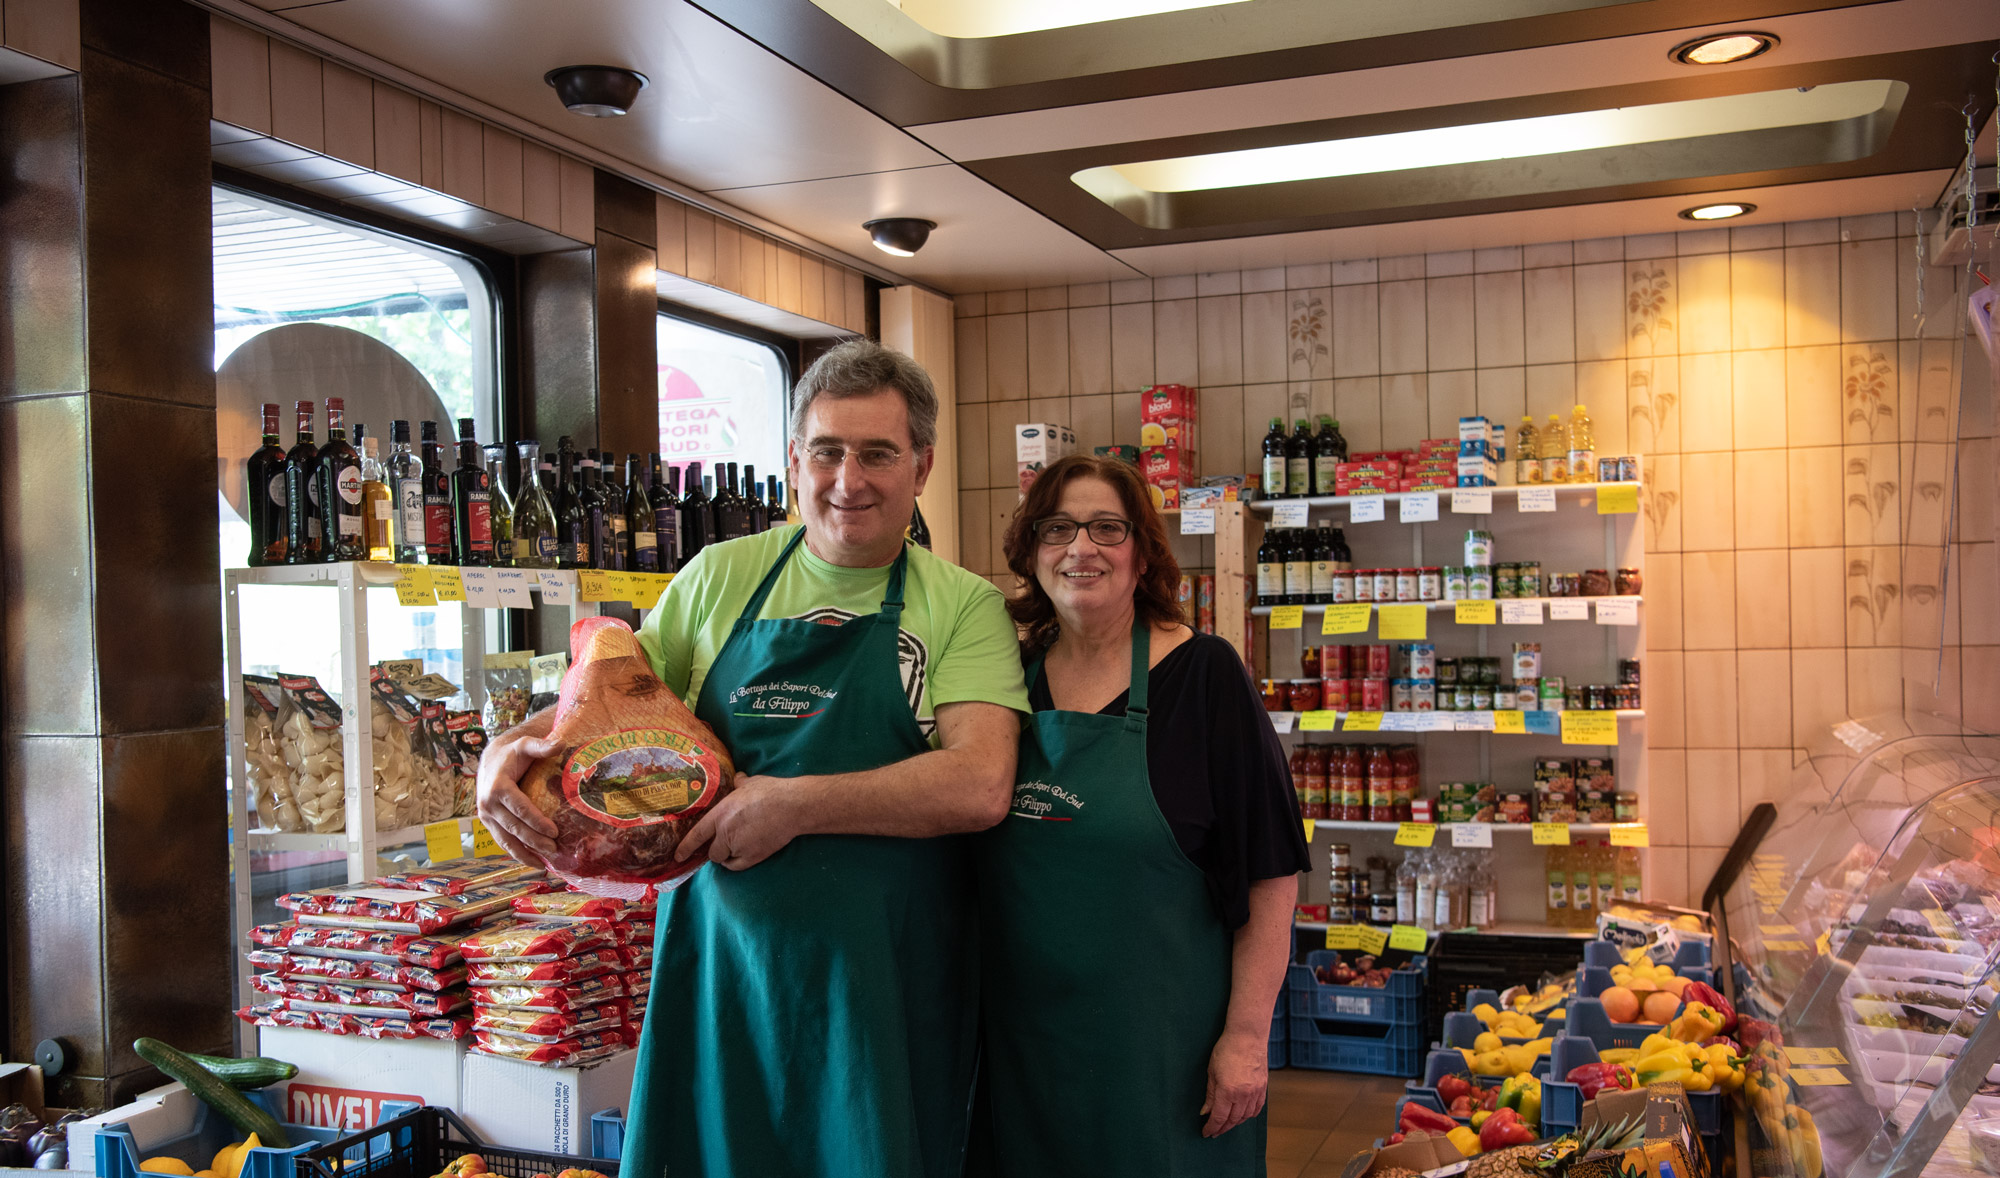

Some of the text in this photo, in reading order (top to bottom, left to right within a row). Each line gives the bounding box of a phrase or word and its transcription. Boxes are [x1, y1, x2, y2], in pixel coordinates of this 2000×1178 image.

[1149, 400, 1172, 414] blond
[659, 408, 720, 422] TEGA
[1147, 460, 1170, 474] blond
[769, 682, 779, 690] dei
[781, 681, 808, 693] Sapori
[752, 696, 810, 713] da Filippo
[1051, 785, 1068, 800] Del
[1066, 794, 1085, 809] Sud
[1021, 794, 1052, 815] Filippo
[293, 1090, 384, 1129] DIVEL
[555, 1098, 561, 1108] DA
[562, 1105, 570, 1127] GRANO
[562, 1128, 569, 1136] DI
